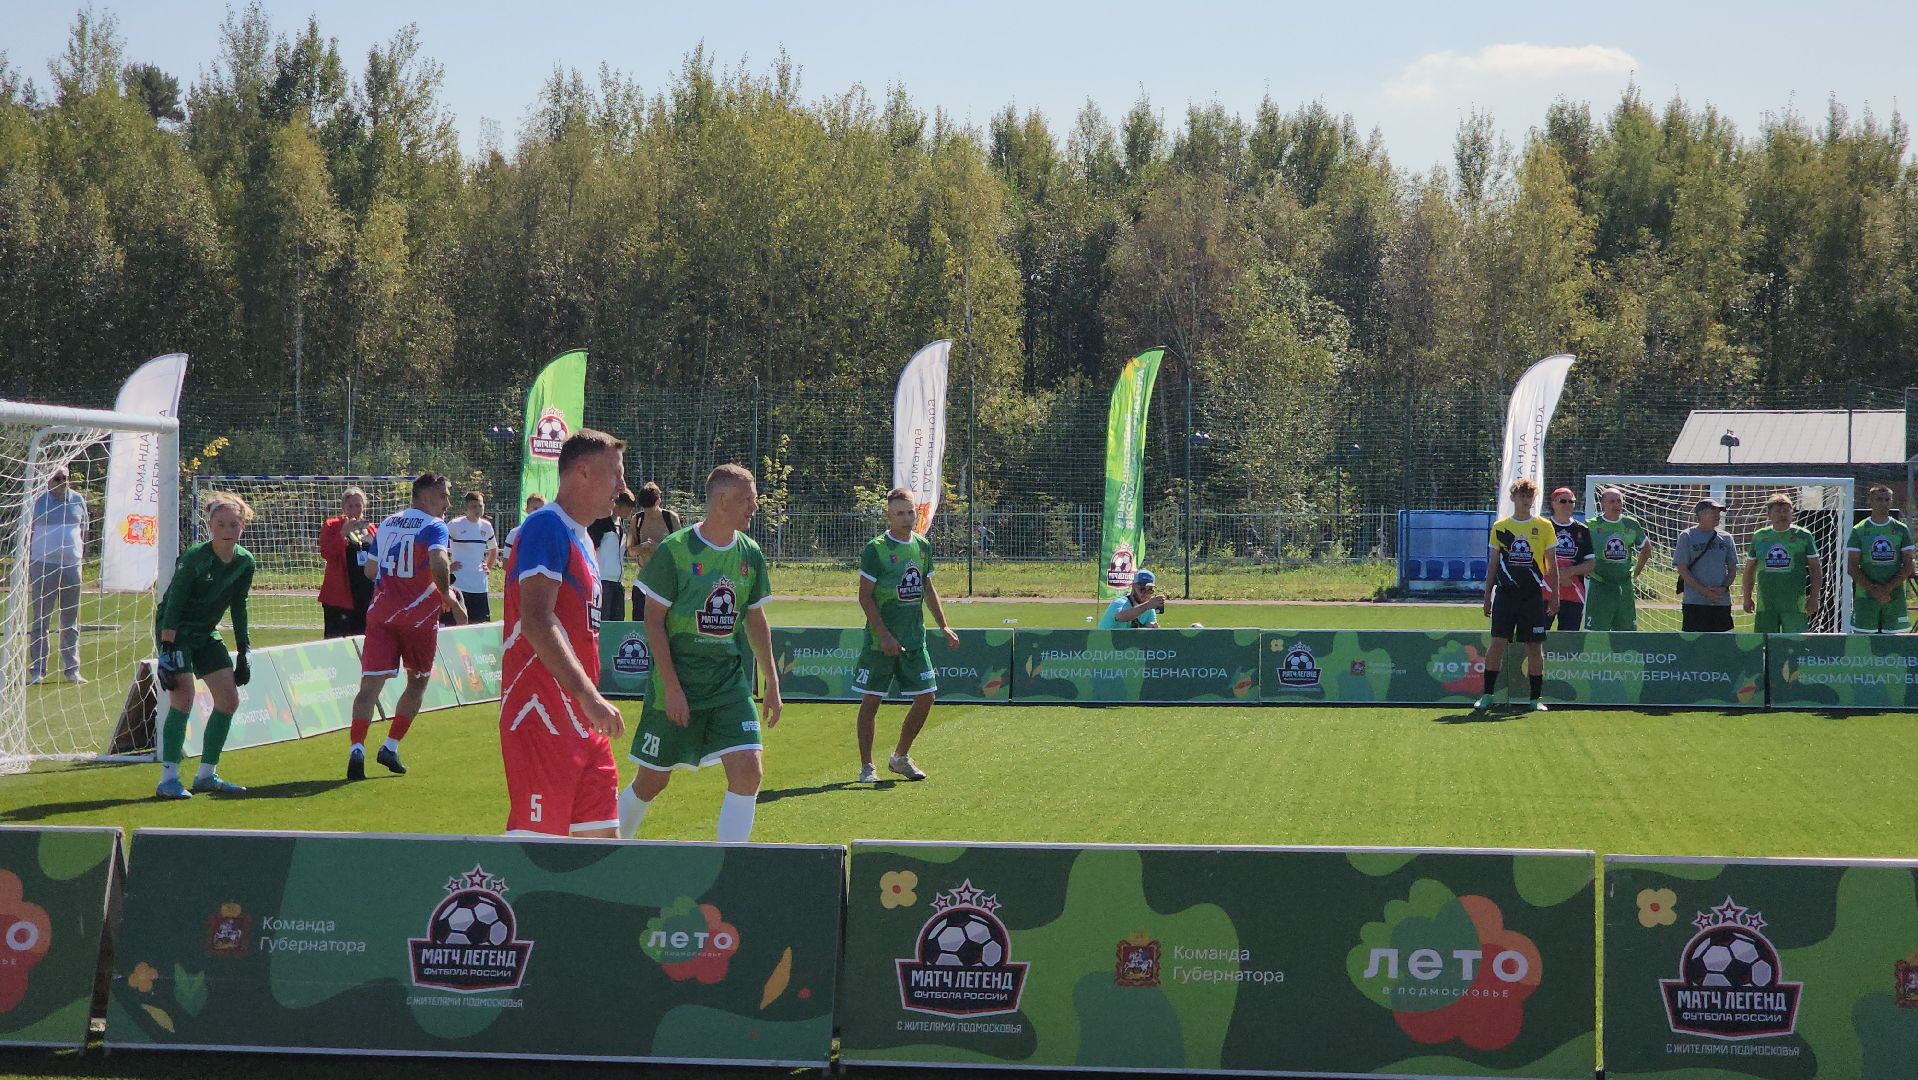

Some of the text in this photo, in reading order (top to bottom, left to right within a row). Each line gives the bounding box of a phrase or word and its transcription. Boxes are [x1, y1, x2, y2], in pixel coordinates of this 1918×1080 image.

[133, 433, 150, 501] КОМАНДА
[380, 531, 416, 579] 40
[1040, 649, 1177, 662] #ВЫХОДИВОДВОР
[1543, 651, 1678, 664] ВЫХОДИВОДВОР
[856, 668, 870, 684] 26
[1040, 667, 1228, 680] #КОМАНДАГУБЕРНАТОРА
[1543, 669, 1731, 682] КОМАНДАГУБЕРНАТОРА
[641, 732, 661, 759] 28
[530, 794, 543, 822] 5
[262, 916, 336, 933] Команда
[259, 936, 367, 954] Губернатора
[647, 930, 733, 950] лето
[421, 948, 517, 968] МАТЧ ЛЕГЕНД
[1173, 945, 1251, 963] Команда
[423, 967, 512, 977] ФУТБОЛА РОССИИ
[1363, 948, 1529, 983] лето
[911, 969, 1014, 991] МАТЧ ЛЕГЕНД
[1172, 966, 1285, 985] Губернатора
[914, 991, 1008, 1000] ФУТБОЛА РОССИИ
[1677, 990, 1788, 1012] МАТЧ ЛЕГЕНД
[1682, 1011, 1782, 1022] ФУТБОЛА РОССИИ
[896, 1021, 1022, 1033] С ЖИТЕЛЯМИ ПОДМОСКОВЬЯ
[1666, 1043, 1801, 1057] С ЖИТЕЛЯМИ ПОДМОСКОВЬЯ
